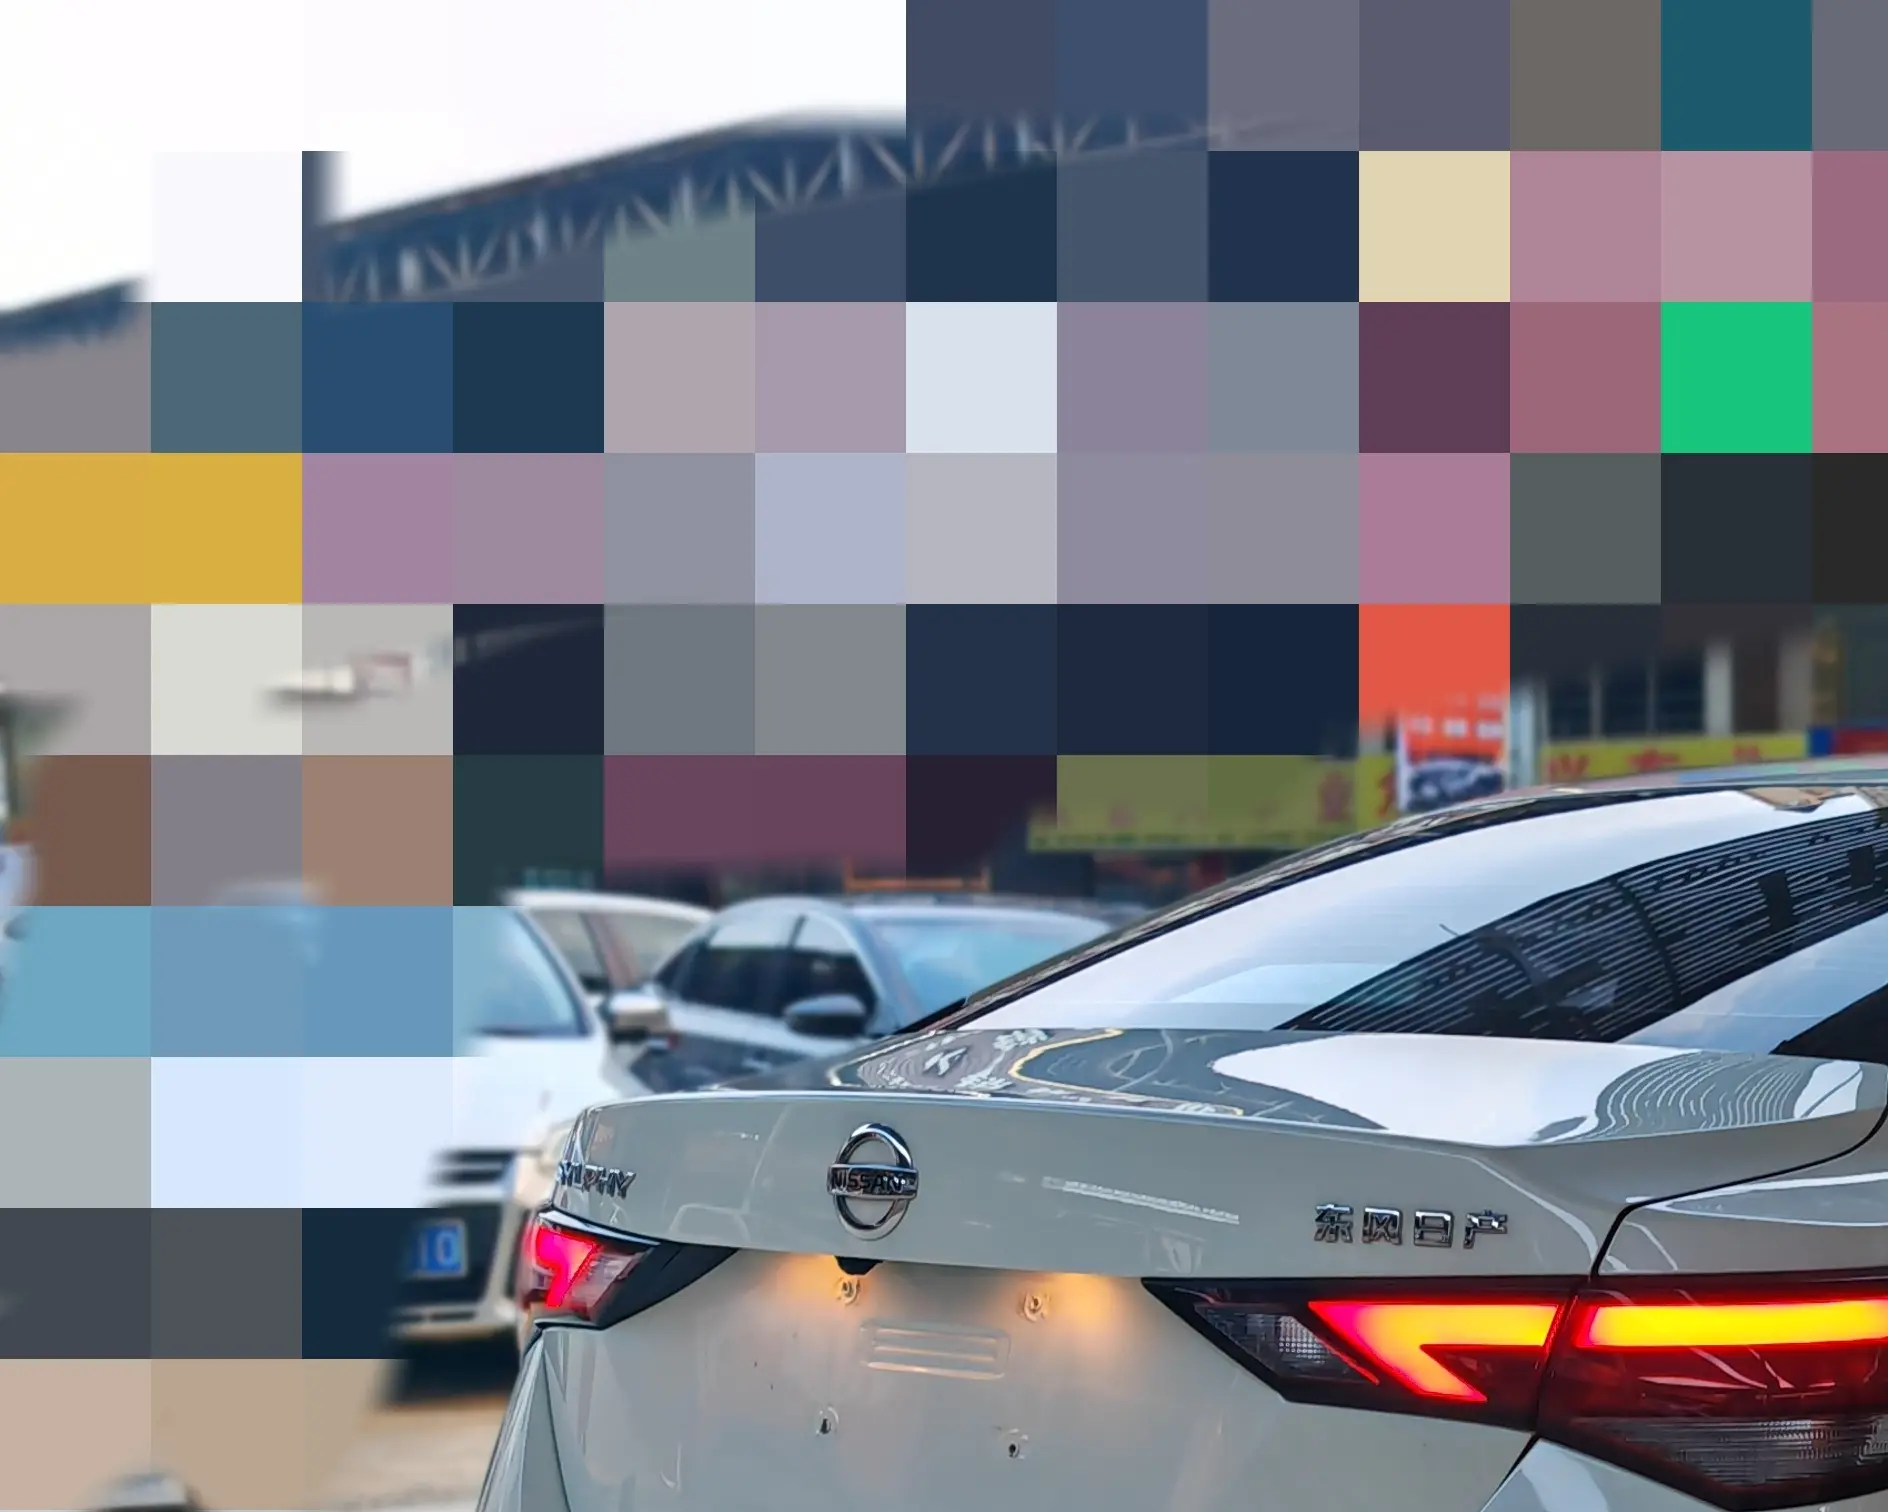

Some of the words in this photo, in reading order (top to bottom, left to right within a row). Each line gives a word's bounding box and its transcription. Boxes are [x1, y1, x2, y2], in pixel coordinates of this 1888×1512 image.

[556, 1161, 637, 1200] YLPHY
[831, 1167, 907, 1195] NISSAN
[1313, 1203, 1508, 1250] 东风日产
